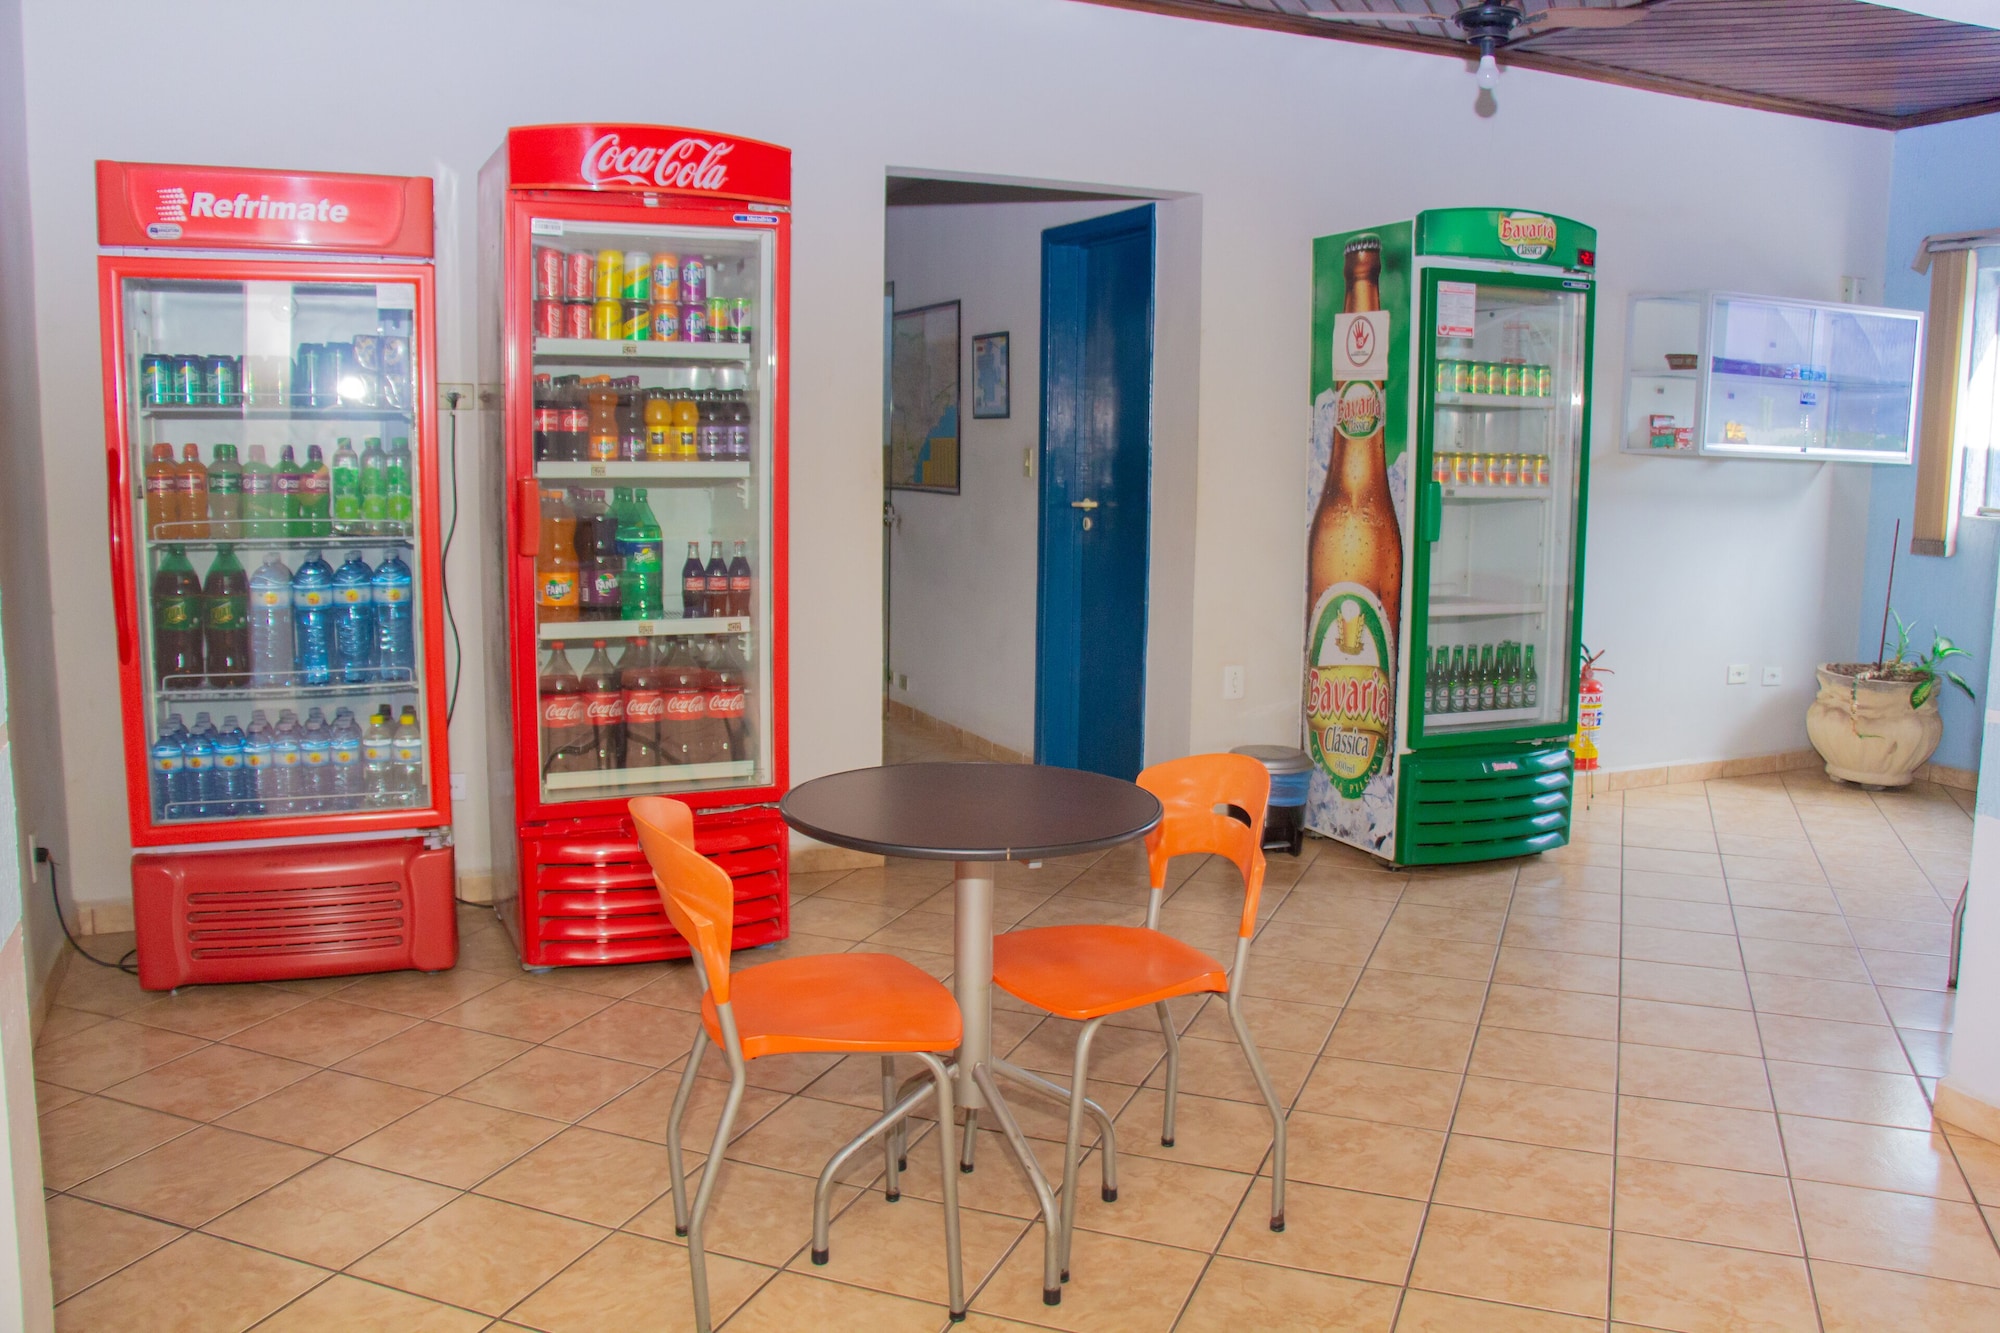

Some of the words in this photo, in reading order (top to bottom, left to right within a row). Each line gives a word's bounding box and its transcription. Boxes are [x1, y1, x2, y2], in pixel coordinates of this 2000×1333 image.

[580, 133, 735, 190] Coca-Cola
[190, 191, 349, 223] Refrimate
[1502, 219, 1555, 241] Bavaria
[683, 267, 705, 281] FANT
[1307, 668, 1389, 726] Bavaria
[1324, 725, 1370, 758] Clássica
